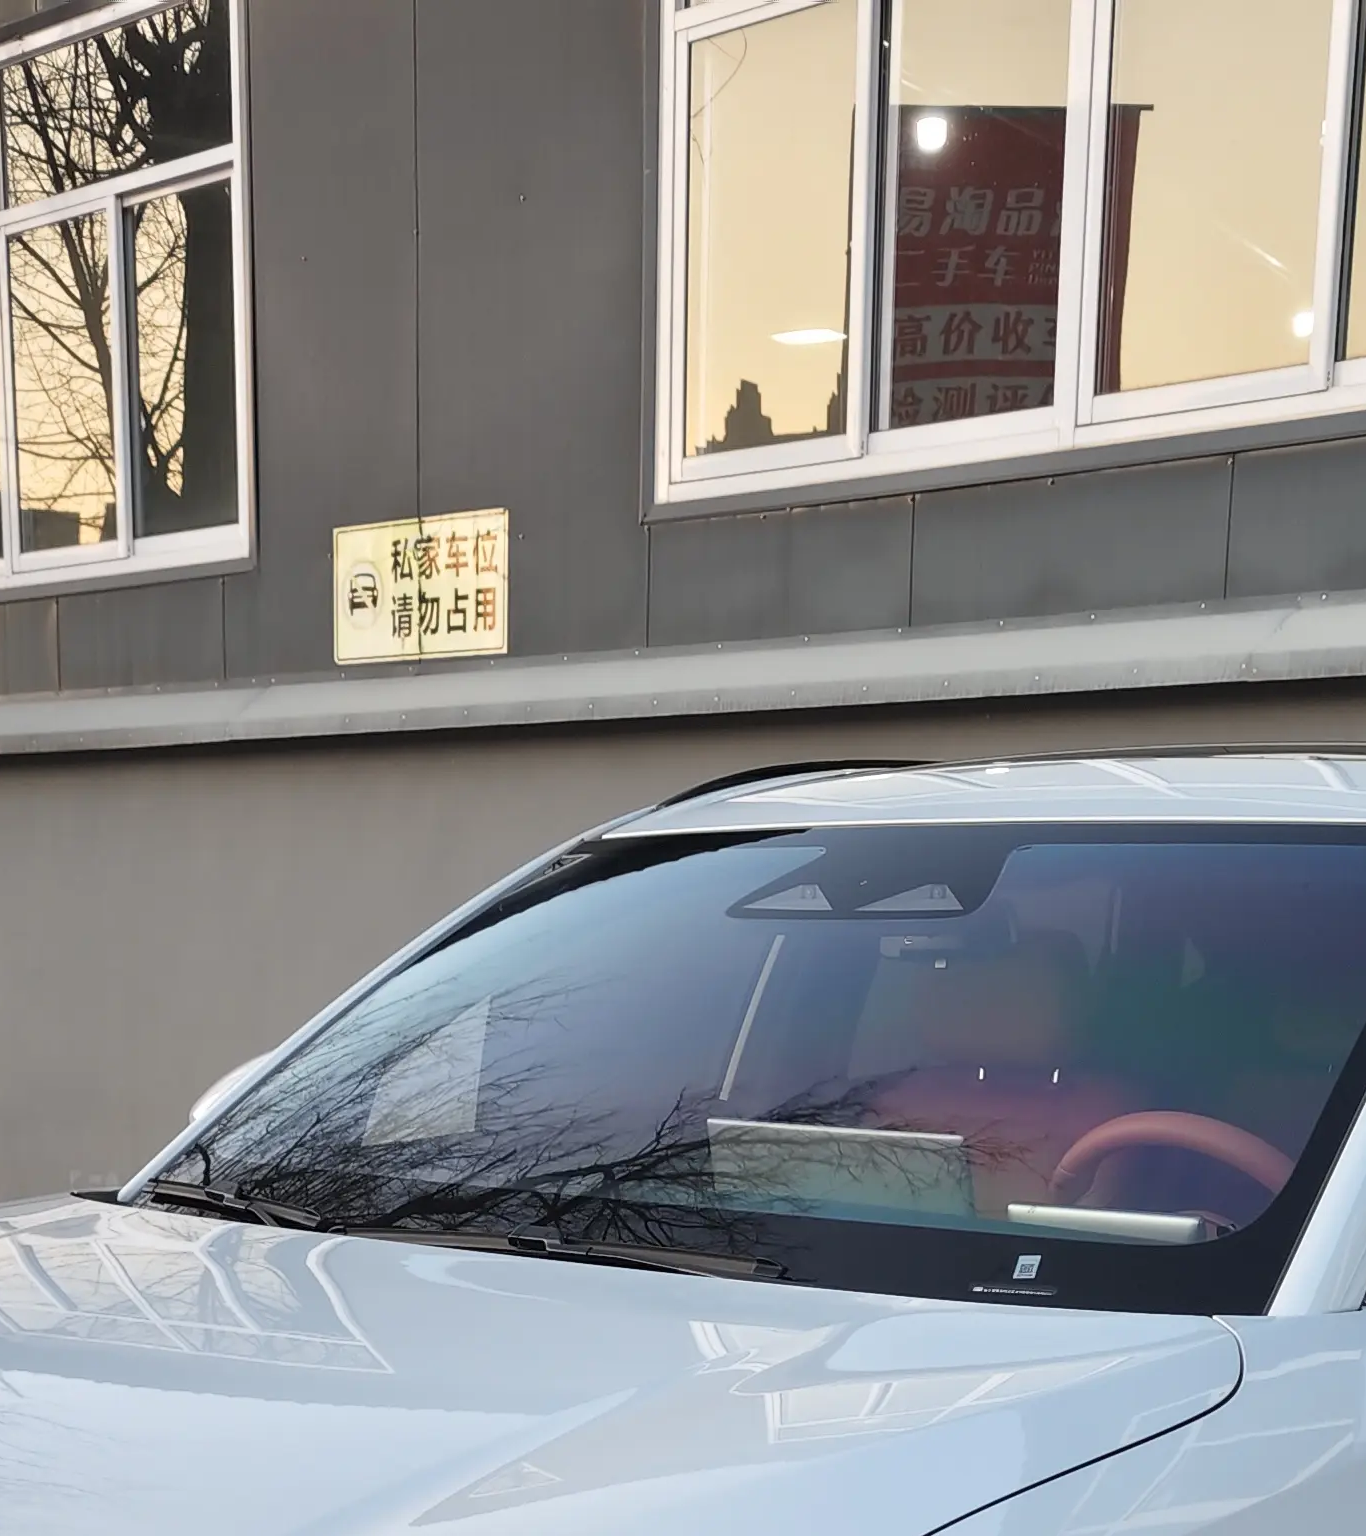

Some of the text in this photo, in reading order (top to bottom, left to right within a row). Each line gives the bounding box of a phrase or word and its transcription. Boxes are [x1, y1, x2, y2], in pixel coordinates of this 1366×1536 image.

[896, 243, 1021, 288] 二手车
[390, 529, 499, 583] 私家车位
[390, 586, 497, 638] 请勿占用
